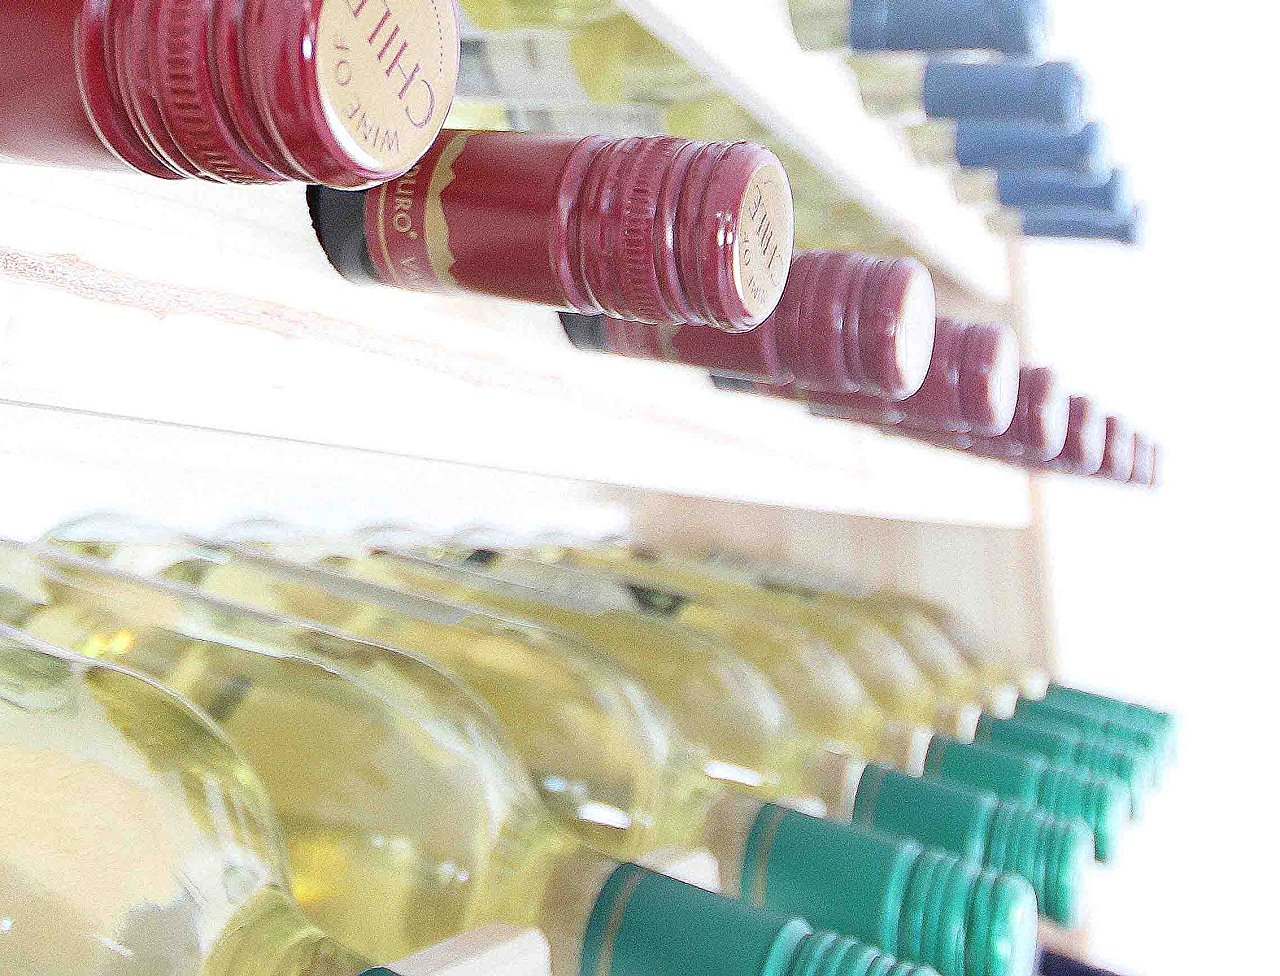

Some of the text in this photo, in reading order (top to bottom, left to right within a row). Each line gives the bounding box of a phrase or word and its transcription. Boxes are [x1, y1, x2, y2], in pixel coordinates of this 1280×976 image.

[331, 34, 401, 154] WINE OF
[748, 184, 783, 288] CHILE
